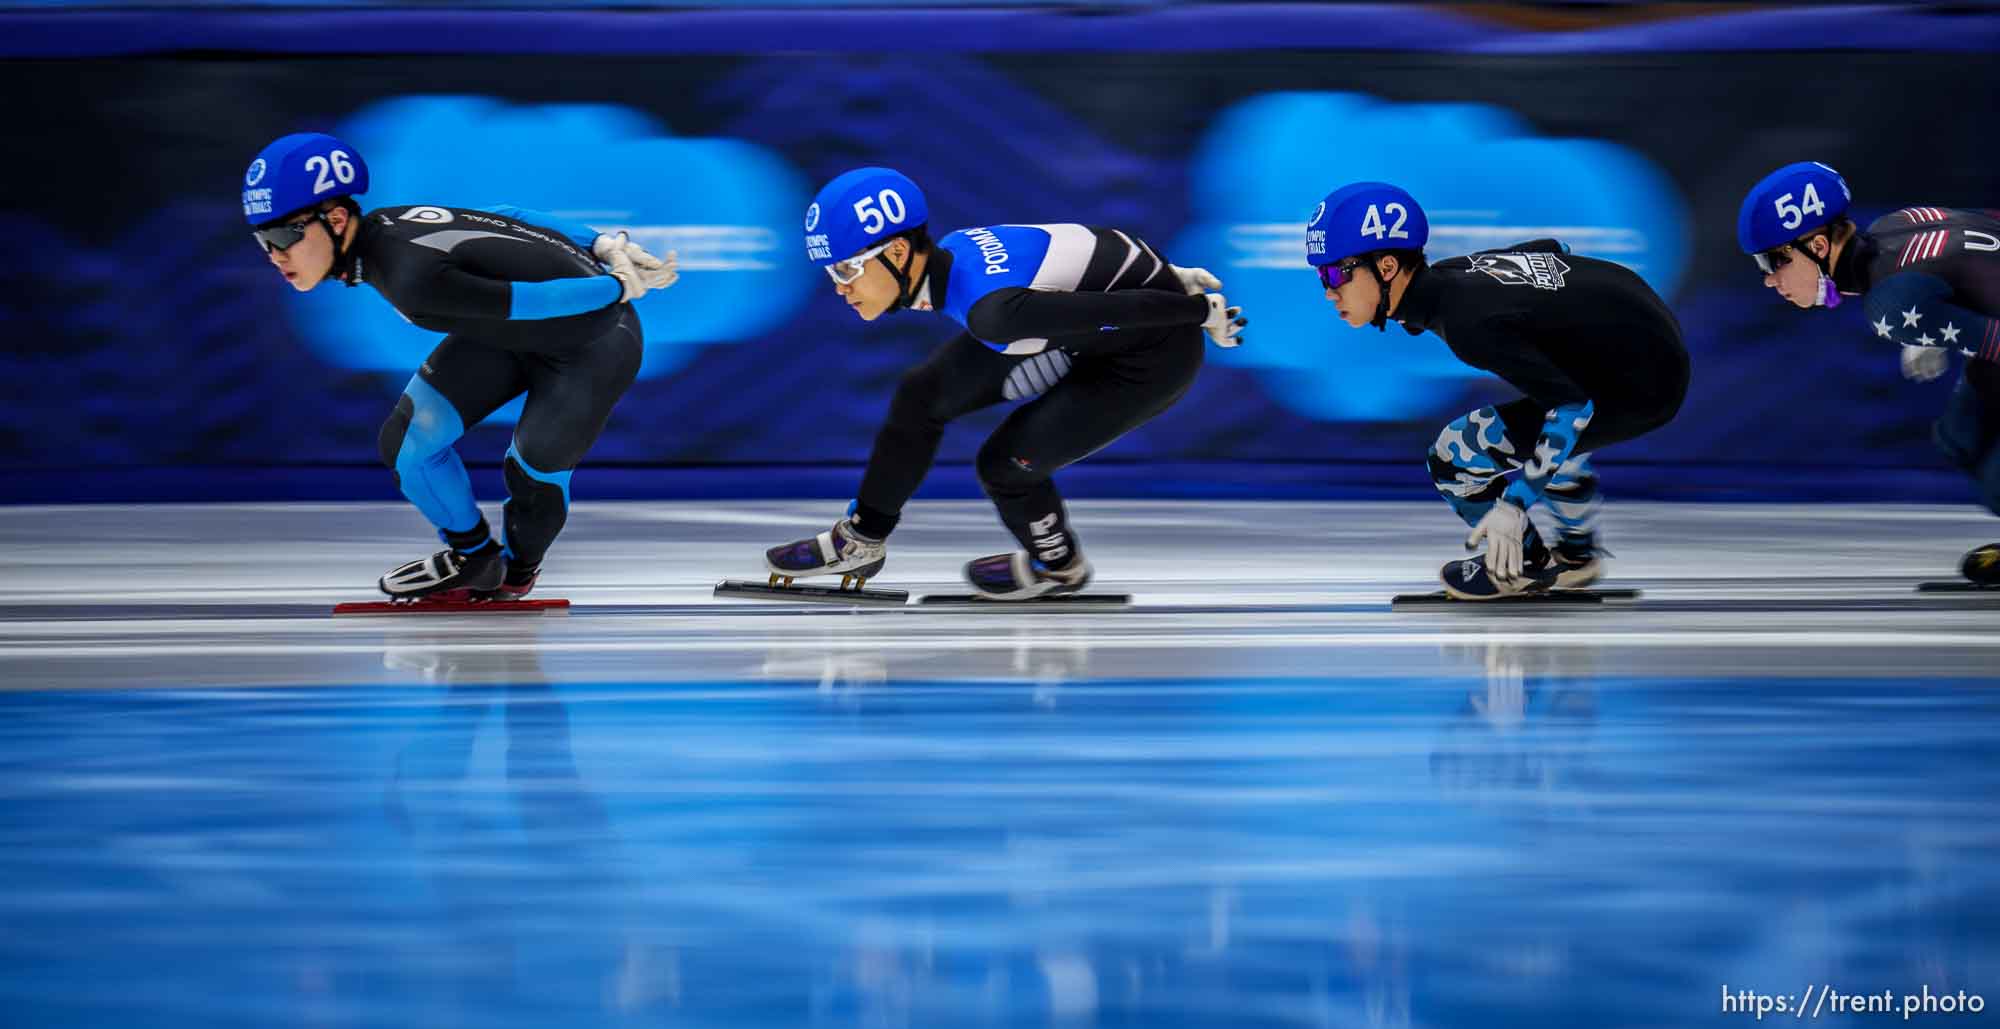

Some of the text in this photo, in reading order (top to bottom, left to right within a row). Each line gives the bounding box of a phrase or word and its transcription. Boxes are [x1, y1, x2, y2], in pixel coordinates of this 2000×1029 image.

[305, 150, 355, 194] 26
[853, 188, 906, 235] 50
[1361, 202, 1409, 240] 42
[1774, 182, 1825, 230] 54
[962, 226, 1010, 275] POTOMA
